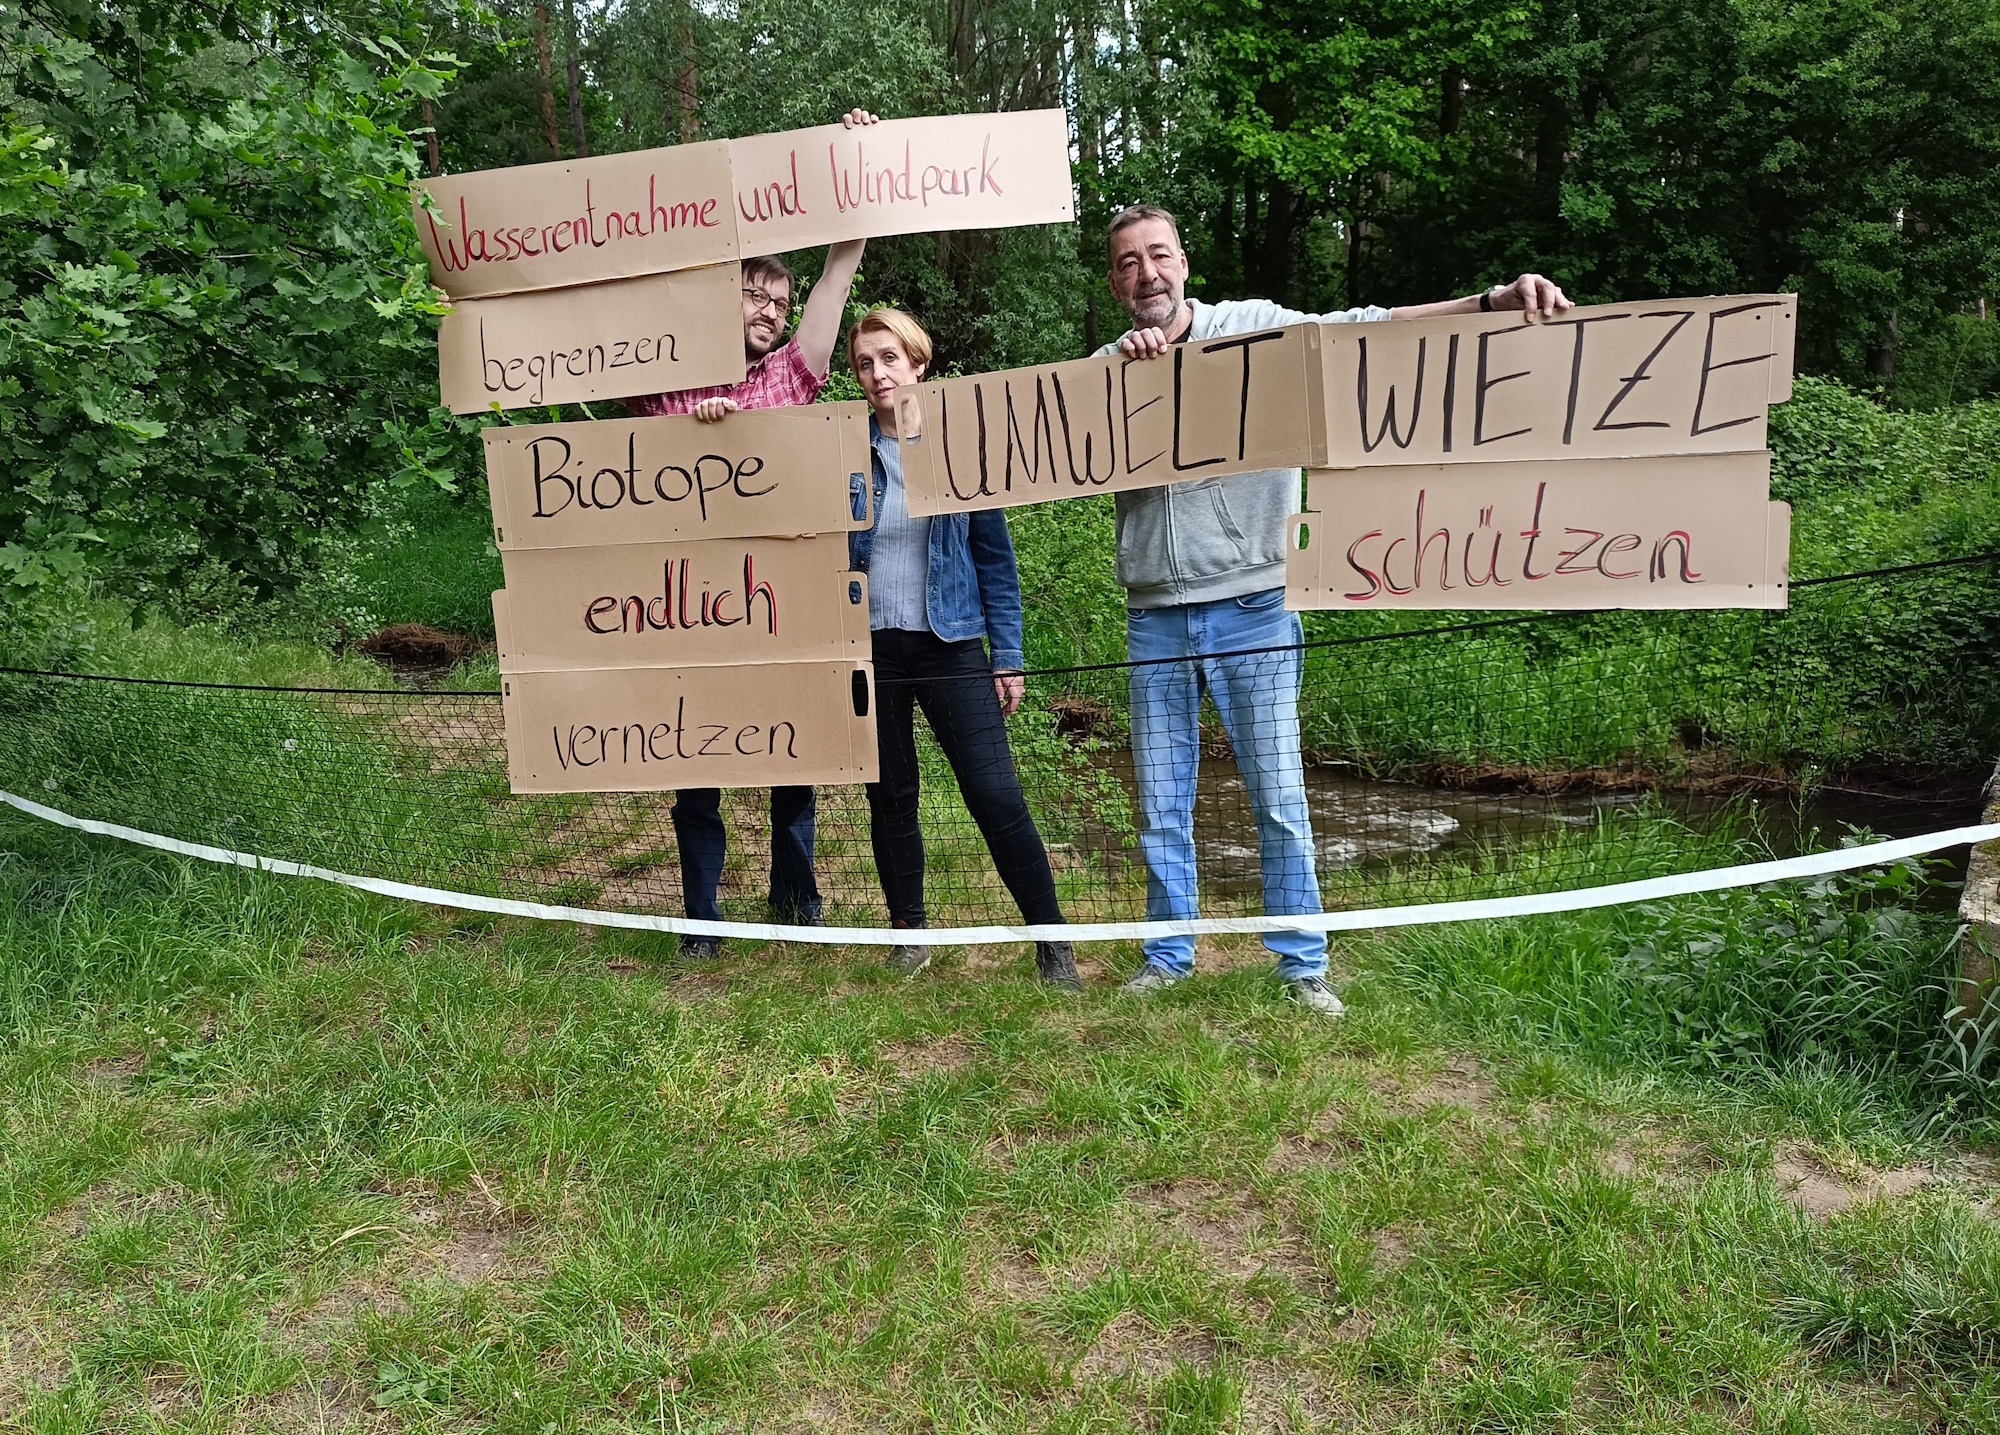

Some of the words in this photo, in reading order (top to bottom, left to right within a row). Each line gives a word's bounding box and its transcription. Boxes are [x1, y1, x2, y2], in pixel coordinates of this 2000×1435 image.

[427, 173, 721, 273] Wasserentnahme
[737, 149, 806, 223] und
[829, 133, 1004, 213] Windpark
[480, 316, 680, 405] begrenzen
[941, 331, 1285, 501] UMWELT
[1357, 301, 1788, 453] WIETZE
[525, 431, 779, 522] Biotope
[1343, 481, 1706, 600] schützen
[583, 553, 778, 637] endlich
[553, 696, 798, 771] vernetzen
